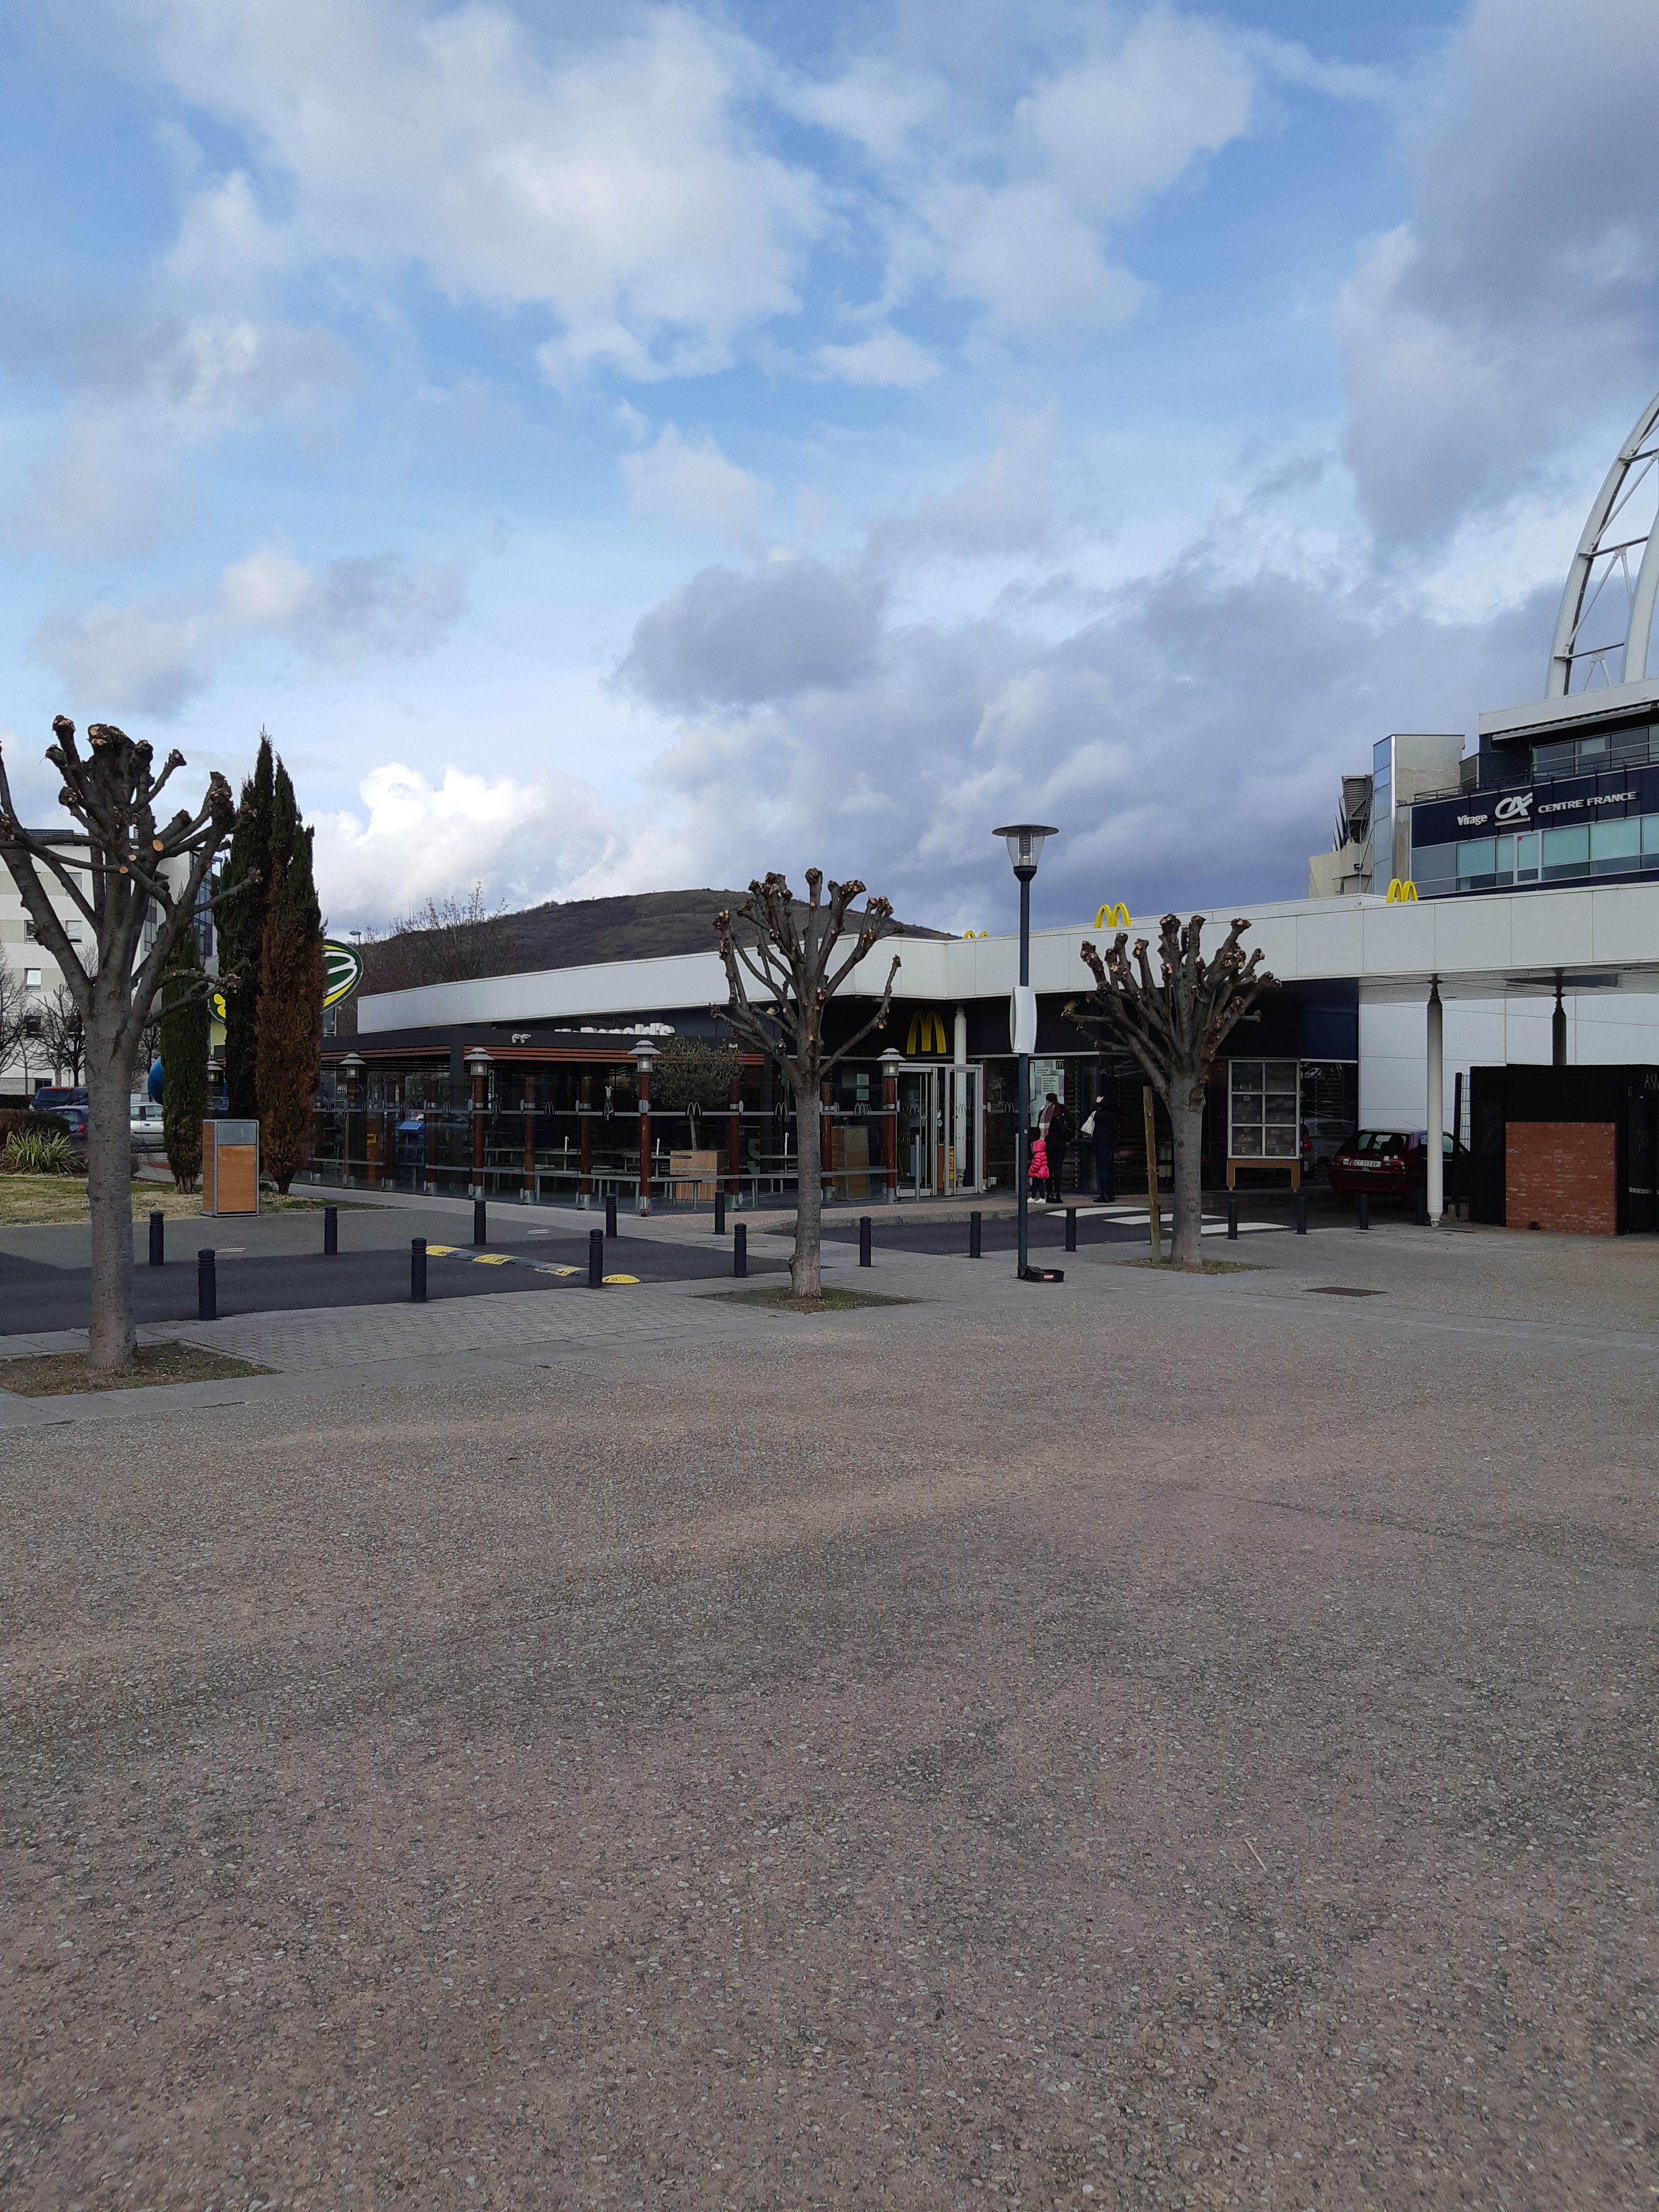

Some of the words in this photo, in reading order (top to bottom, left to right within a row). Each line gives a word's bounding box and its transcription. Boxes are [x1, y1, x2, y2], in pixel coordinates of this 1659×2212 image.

[1457, 815, 1488, 826] Virage
[1538, 799, 1584, 813] CENTRE
[1587, 792, 1637, 806] FRANCE
